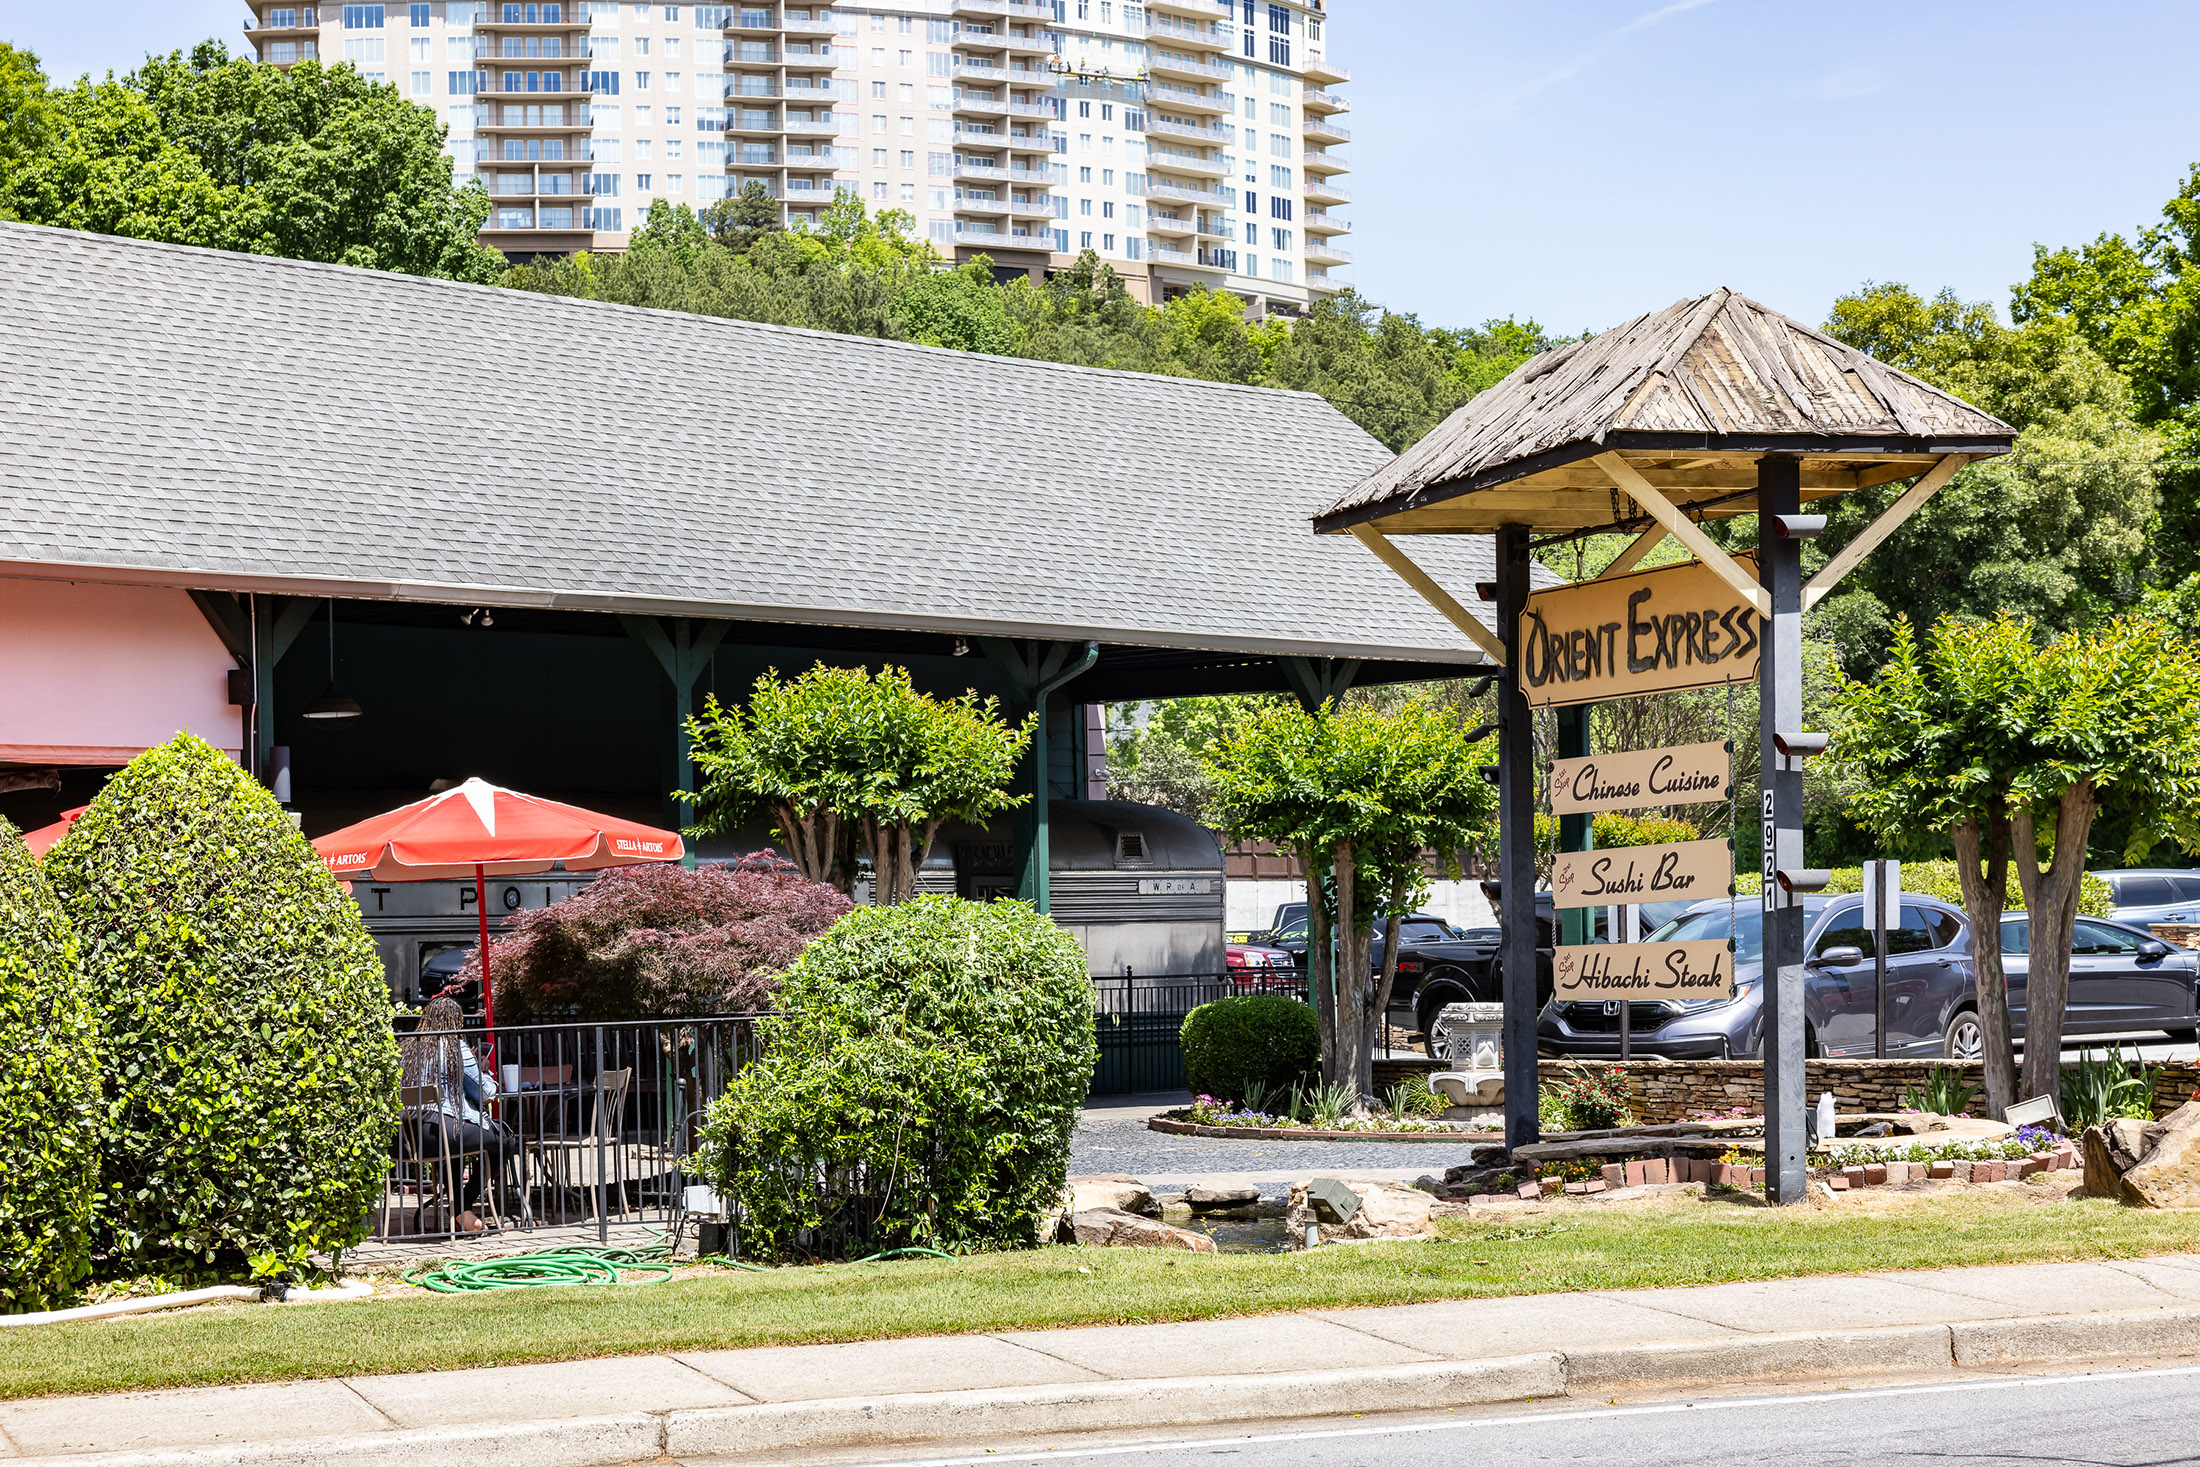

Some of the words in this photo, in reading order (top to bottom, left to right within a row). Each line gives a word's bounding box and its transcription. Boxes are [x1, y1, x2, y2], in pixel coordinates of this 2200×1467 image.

[1526, 606, 1621, 687] ORIENT
[1627, 588, 1757, 674] EXPRESS
[1554, 776, 1570, 797] Stop
[1573, 763, 1640, 801] Chinese
[1649, 755, 1719, 794] Cuisine
[336, 851, 367, 866] ARTOIS
[616, 838, 637, 851] STELLA
[642, 841, 663, 853] ARTOIS
[1764, 792, 1774, 910] 2921
[1559, 872, 1574, 893] Stop
[1581, 857, 1643, 895] Sushi
[1650, 851, 1695, 891] Bar
[1559, 961, 1574, 980] Stop
[1561, 953, 1650, 989] Hibachi
[1654, 949, 1722, 988] Steak
